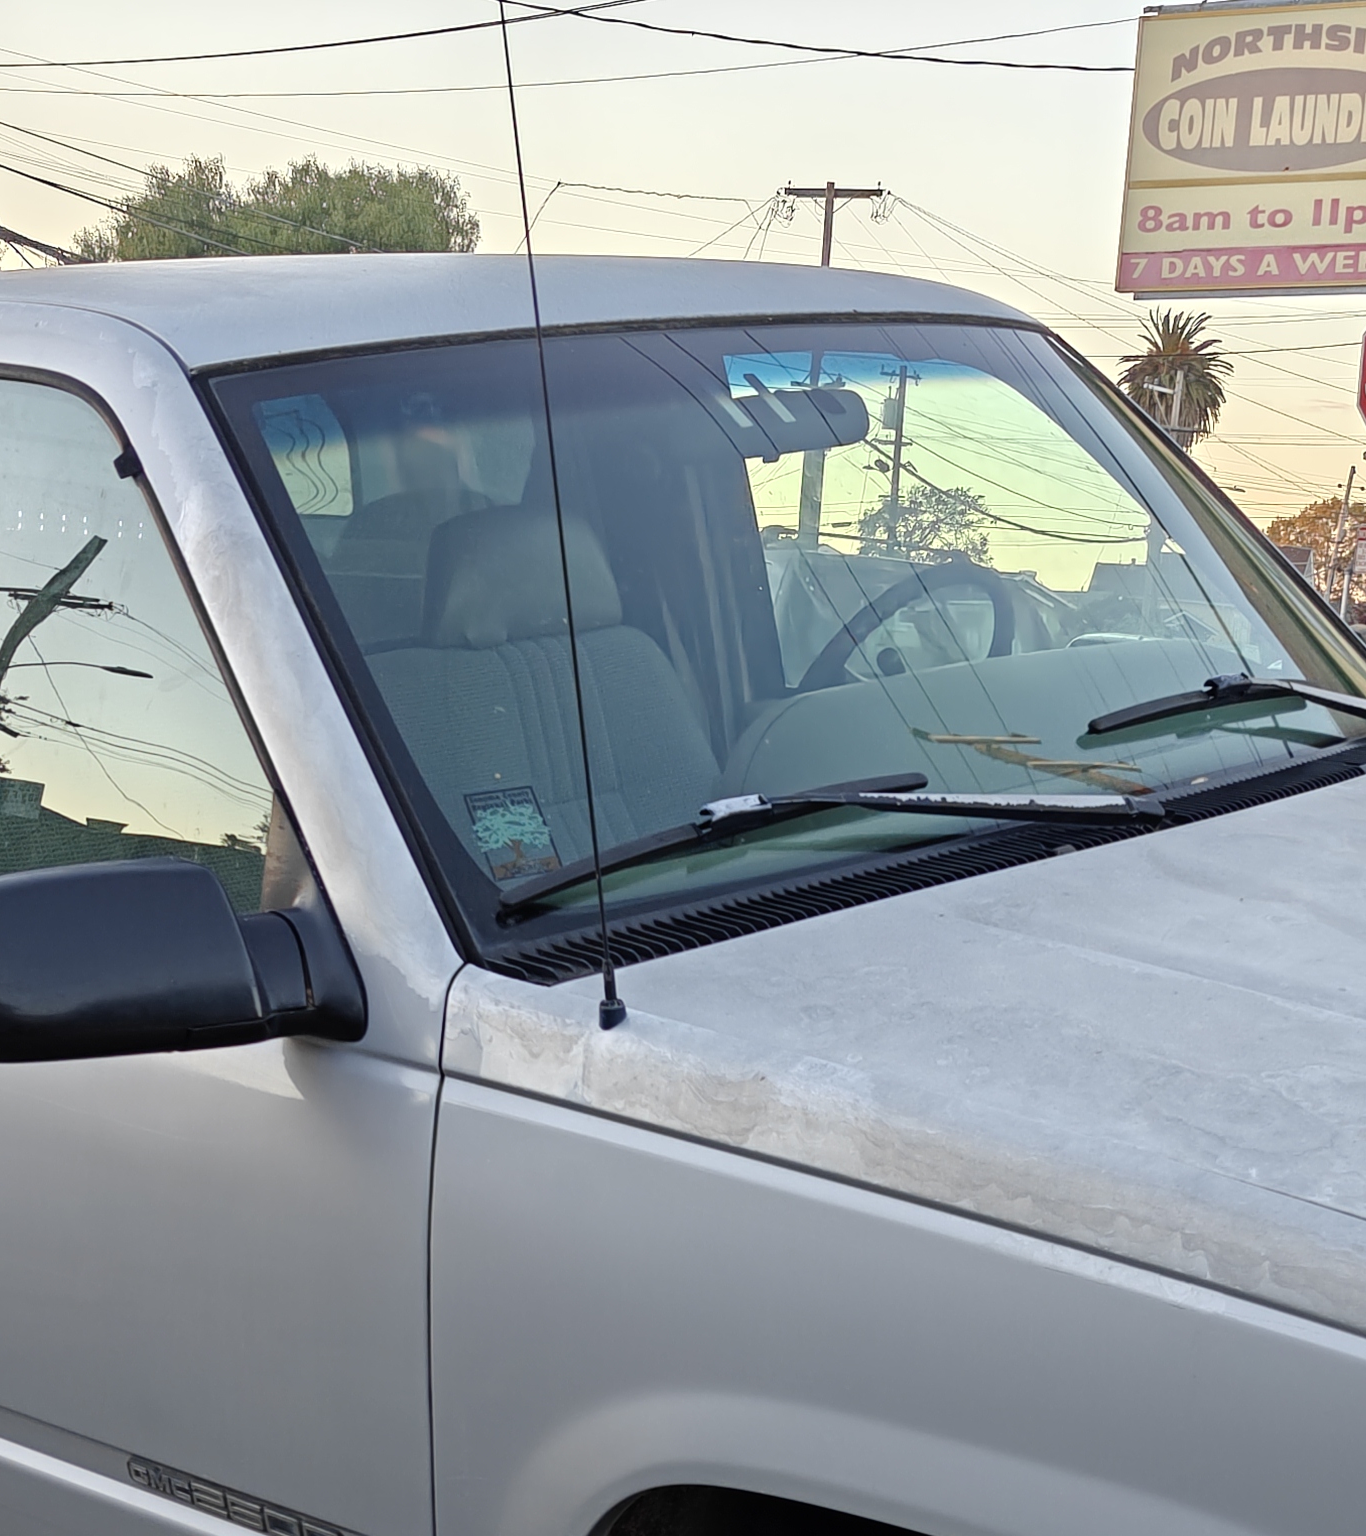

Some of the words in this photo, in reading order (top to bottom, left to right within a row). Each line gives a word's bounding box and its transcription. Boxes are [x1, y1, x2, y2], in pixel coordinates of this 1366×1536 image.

[1158, 97, 1237, 151] COIN
[1137, 204, 1231, 234] 8am
[1247, 204, 1294, 230] to
[1130, 257, 1148, 279] 7
[1161, 254, 1246, 280] DAYS
[1256, 253, 1279, 276] A
[129, 1460, 192, 1503] GMC
